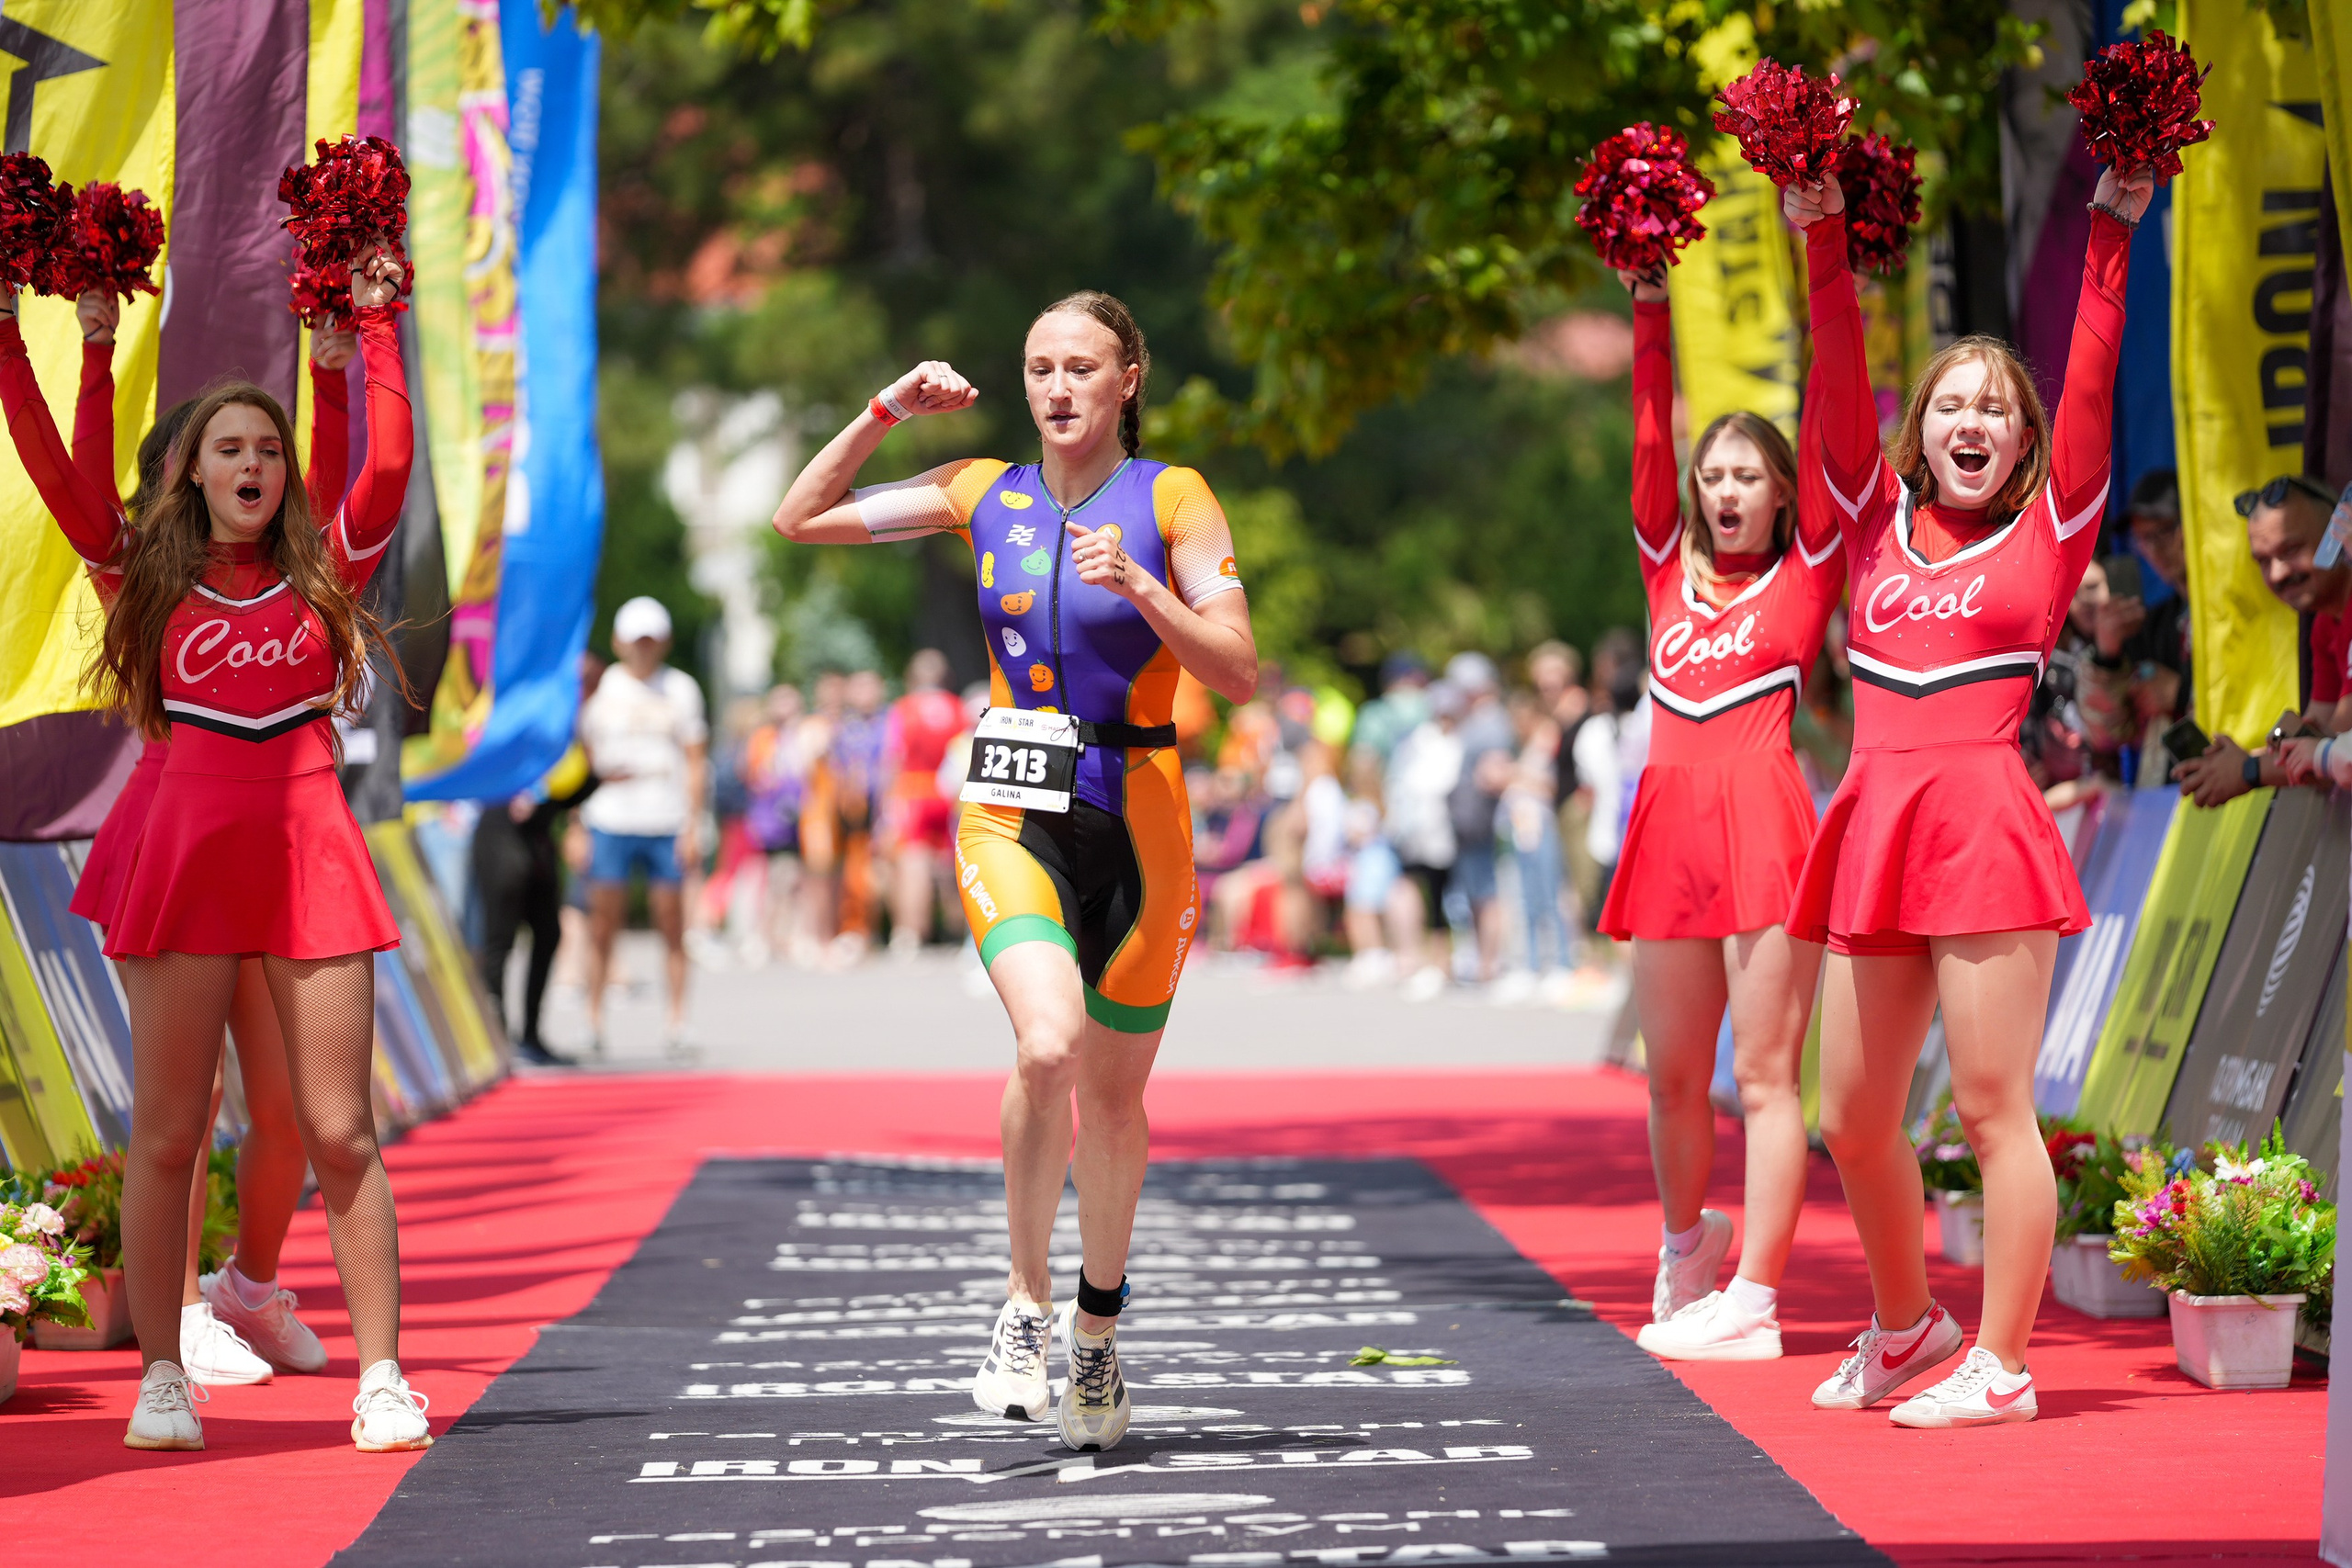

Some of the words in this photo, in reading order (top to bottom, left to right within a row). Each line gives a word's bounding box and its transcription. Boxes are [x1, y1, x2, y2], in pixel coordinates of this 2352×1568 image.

[1114, 543, 1126, 586] 213
[1864, 573, 1985, 634] Cool
[175, 618, 311, 684] Cool
[1654, 613, 1756, 679] Cool
[1000, 716, 1012, 725] IRON
[1018, 717, 1035, 728] STAR
[980, 744, 1048, 784] 3213
[990, 787, 1022, 800] GALINA
[1166, 936, 1188, 994] ДИКСИ
[686, 1377, 975, 1395] IRON
[1150, 1370, 1472, 1385] STAR
[639, 1458, 983, 1477] IRON
[1168, 1445, 1535, 1467] STAR
